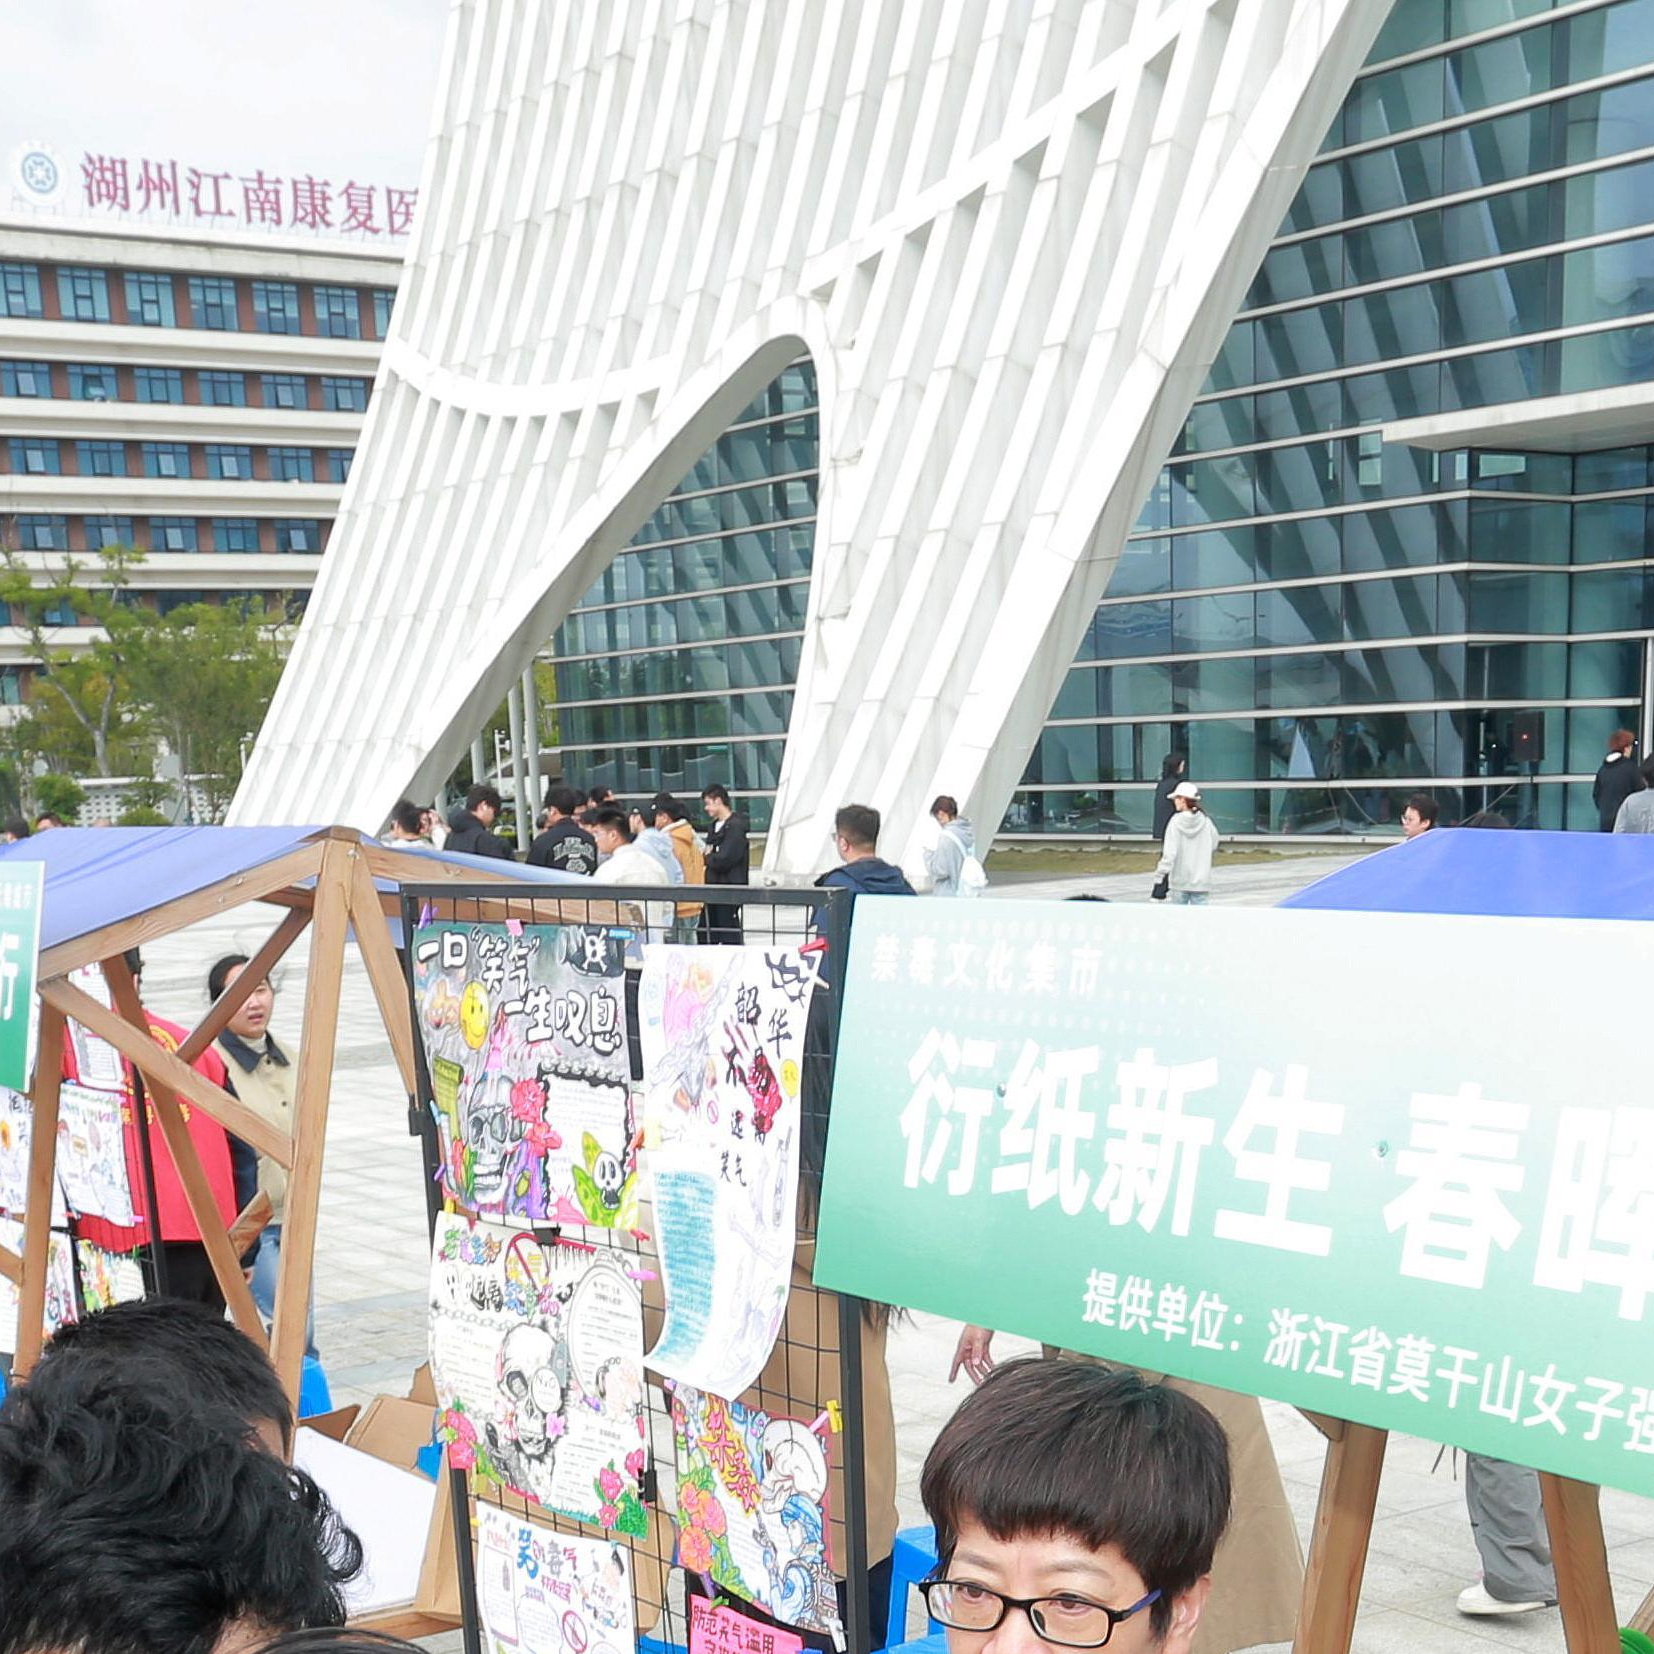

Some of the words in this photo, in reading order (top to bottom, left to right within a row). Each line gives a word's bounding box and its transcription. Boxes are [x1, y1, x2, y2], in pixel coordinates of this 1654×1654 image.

[80, 151, 419, 236] 湖州江南康复医
[503, 984, 623, 1054] 一生叹息
[900, 1025, 1345, 1258] 衍纸新生
